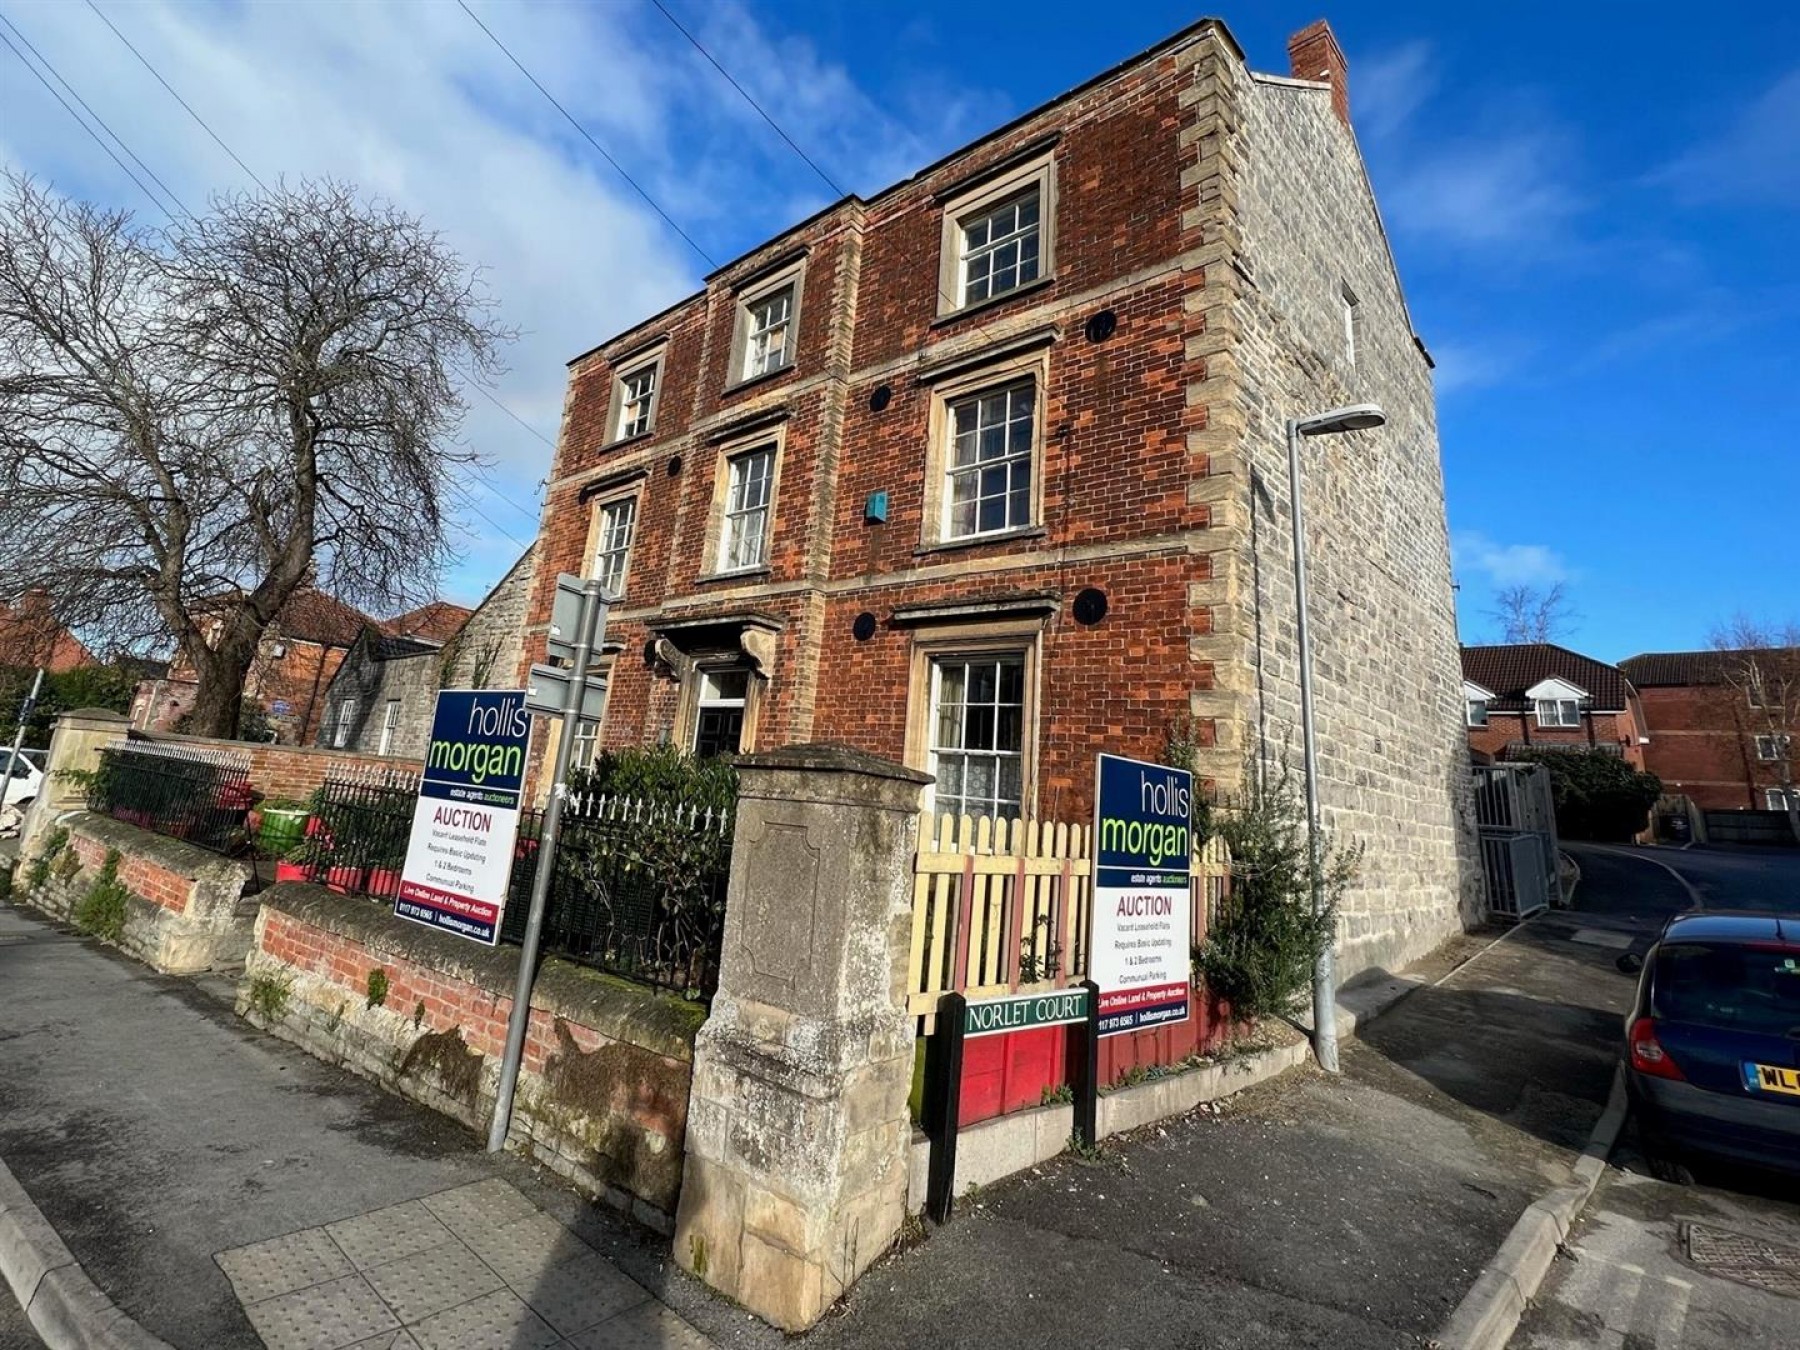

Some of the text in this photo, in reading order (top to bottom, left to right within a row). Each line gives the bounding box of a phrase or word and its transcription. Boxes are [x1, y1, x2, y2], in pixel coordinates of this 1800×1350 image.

[468, 697, 528, 738] hollis
[428, 740, 521, 784] morgan
[450, 788, 466, 798] estate
[466, 790, 484, 801] agents
[1141, 770, 1189, 818] hollis
[433, 806, 492, 832] AUCTION
[449, 832, 474, 844] Leasehold
[1102, 818, 1188, 866] morgan
[428, 842, 486, 865] Requires Basic Updating
[447, 862, 472, 875] Bedrooms
[426, 874, 474, 894] Communal Parking
[404, 886, 414, 894] Live
[415, 888, 430, 899] Online
[430, 893, 444, 904] Land
[450, 896, 471, 912] Property
[471, 904, 492, 916] Auction
[1116, 896, 1172, 916] AUCTION
[438, 914, 490, 938] hollismorgan.co.uk
[1115, 939, 1171, 950] Requires Basic Updating
[1138, 955, 1162, 965] Bedrooms
[1119, 971, 1167, 984] Communal Parking
[1110, 996, 1127, 1006] Online
[1128, 993, 1140, 1003] Land
[1146, 990, 1166, 1001] Property
[1166, 988, 1185, 996] Auction
[969, 995, 1082, 1030] NORLET COURT
[1099, 1019, 1109, 1030] 117
[1140, 1006, 1186, 1022] hollismorgan.co.uk
